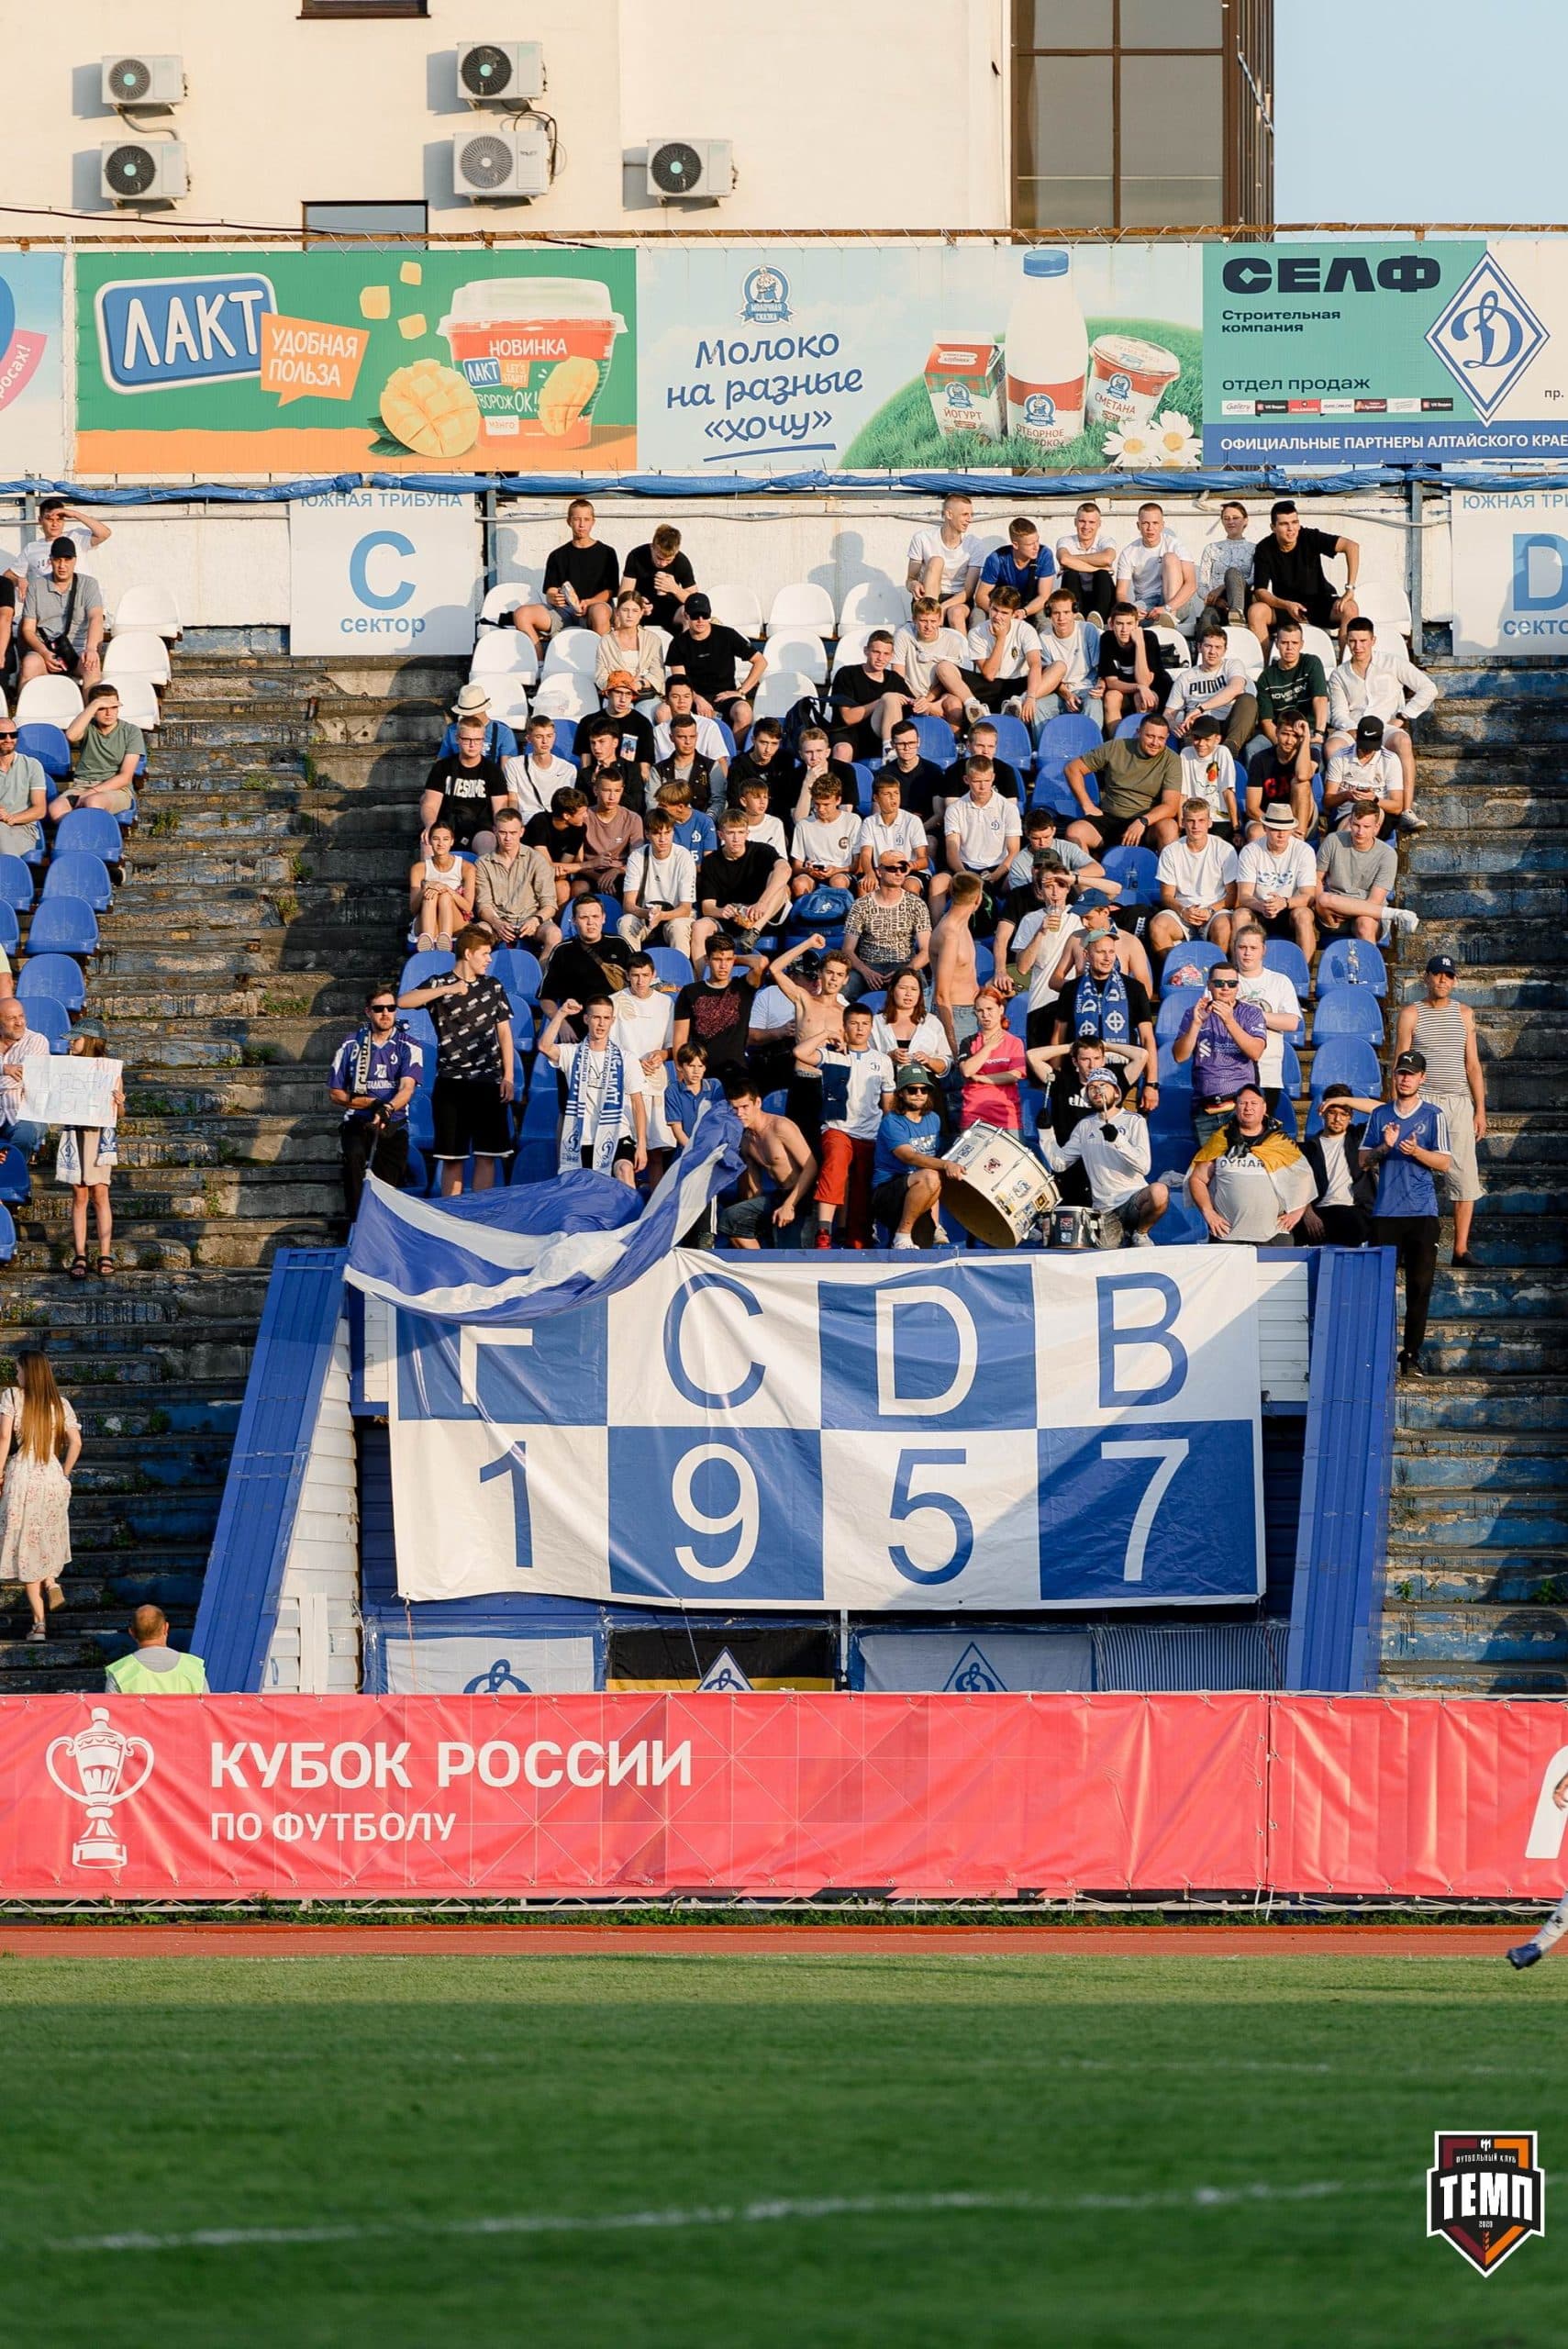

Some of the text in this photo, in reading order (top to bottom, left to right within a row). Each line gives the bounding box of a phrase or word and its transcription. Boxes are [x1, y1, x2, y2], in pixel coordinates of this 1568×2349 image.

[1222, 255, 1440, 294] СЕЛФ
[1222, 310, 1340, 321] Строительная
[122, 290, 264, 369] ЛАКТ
[1221, 324, 1304, 334] компания
[271, 328, 357, 360] УДОБНАЯ
[489, 339, 568, 357] НОВИНКА
[695, 333, 840, 368] Молоко
[269, 357, 341, 386] ПОЛЬЗА
[467, 362, 498, 384] ЛАКТ
[667, 369, 863, 410] на разные
[1222, 376, 1371, 393] отдел продаж
[1544, 389, 1564, 401] пр.
[943, 407, 983, 420] ЙОГУРТ
[1095, 392, 1136, 415] СМЕТАНА
[704, 410, 833, 442] «хочу»
[1016, 423, 1064, 438] ОТБОРНОЕ
[1220, 436, 1340, 451] ОФИЦИАЛЬНЫЕ
[1344, 435, 1424, 450] ПАРТНЕРЫ
[1428, 432, 1528, 449] АЛТАЙСКОГО
[301, 493, 463, 507] ЮЖНАЯ ТРИБУНА
[1462, 495, 1535, 508] ЮЖНАЯ
[1513, 533, 1568, 611] D
[340, 618, 426, 635] сектор
[1189, 674, 1227, 696] PUMA
[478, 1438, 1190, 1586] 1957
[211, 1740, 692, 1788] КУБОК РОССИИ
[211, 1813, 456, 1842] ПО ФУТБОЛУ
